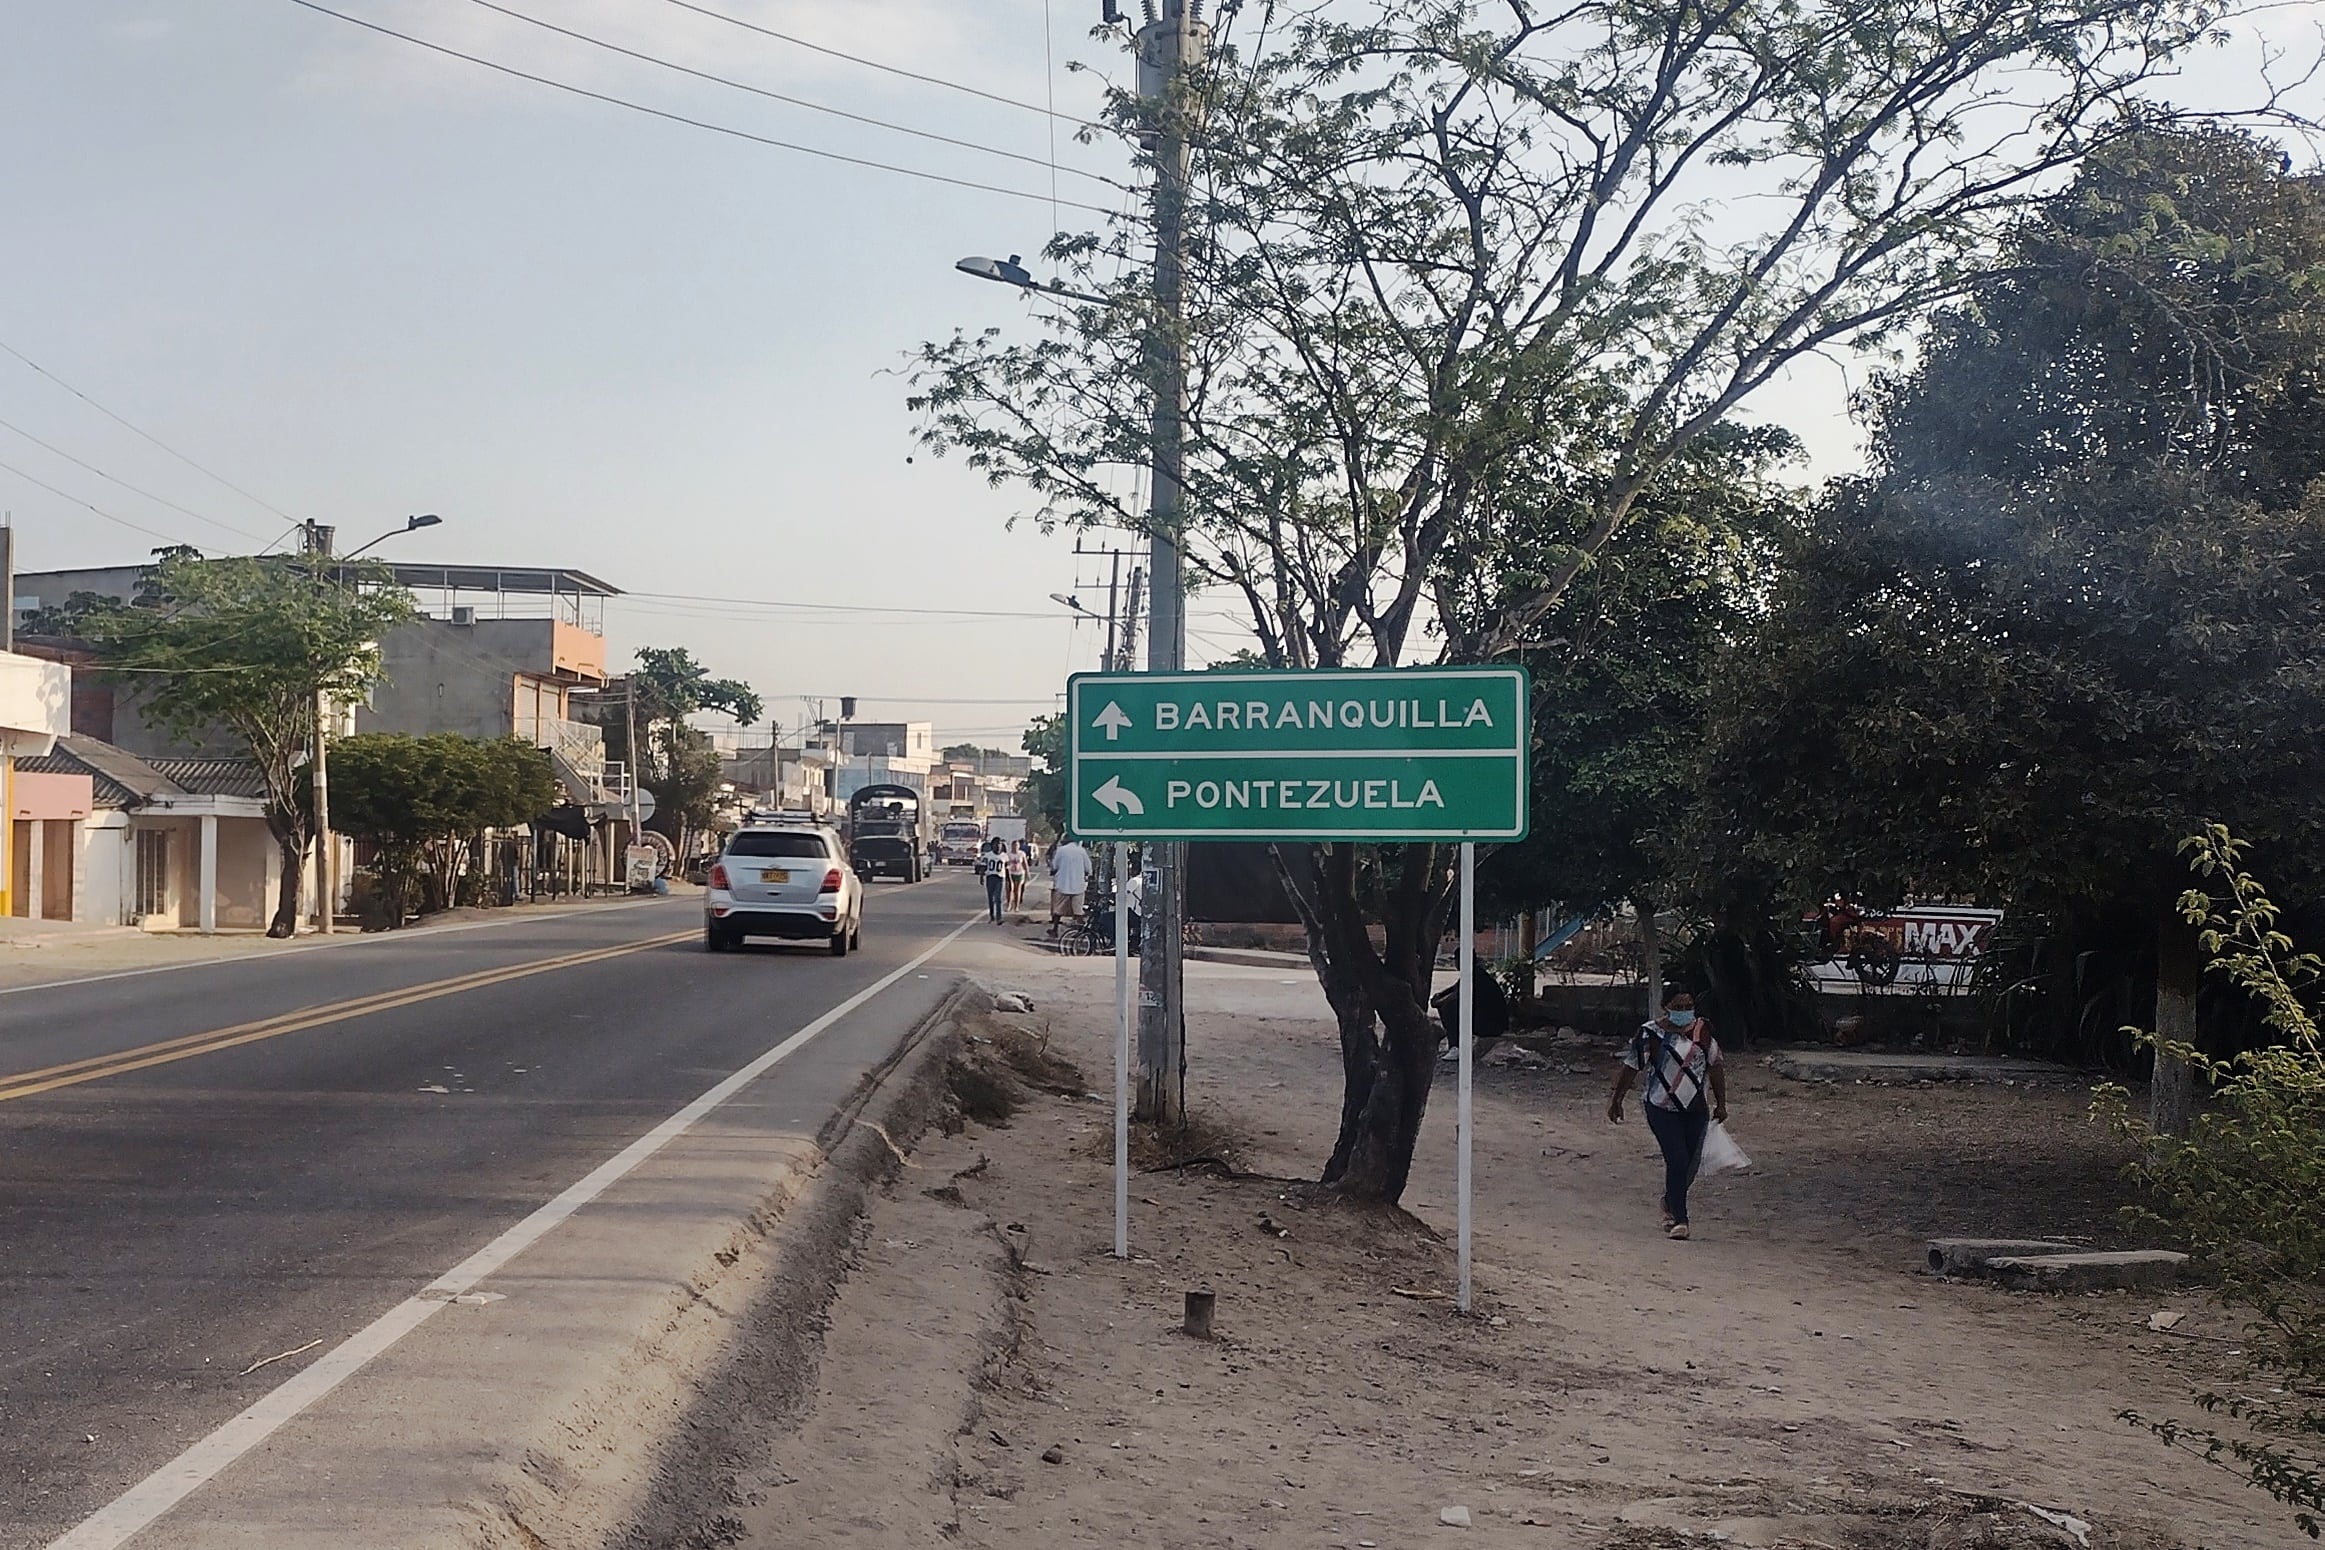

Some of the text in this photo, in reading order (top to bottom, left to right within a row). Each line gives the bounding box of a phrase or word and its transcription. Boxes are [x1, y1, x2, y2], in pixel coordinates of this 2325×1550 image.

[1156, 698, 1493, 730] BARRANQUILLA
[1168, 779, 1445, 809] PONTEZUELA
[1904, 921, 1982, 956] MAX
